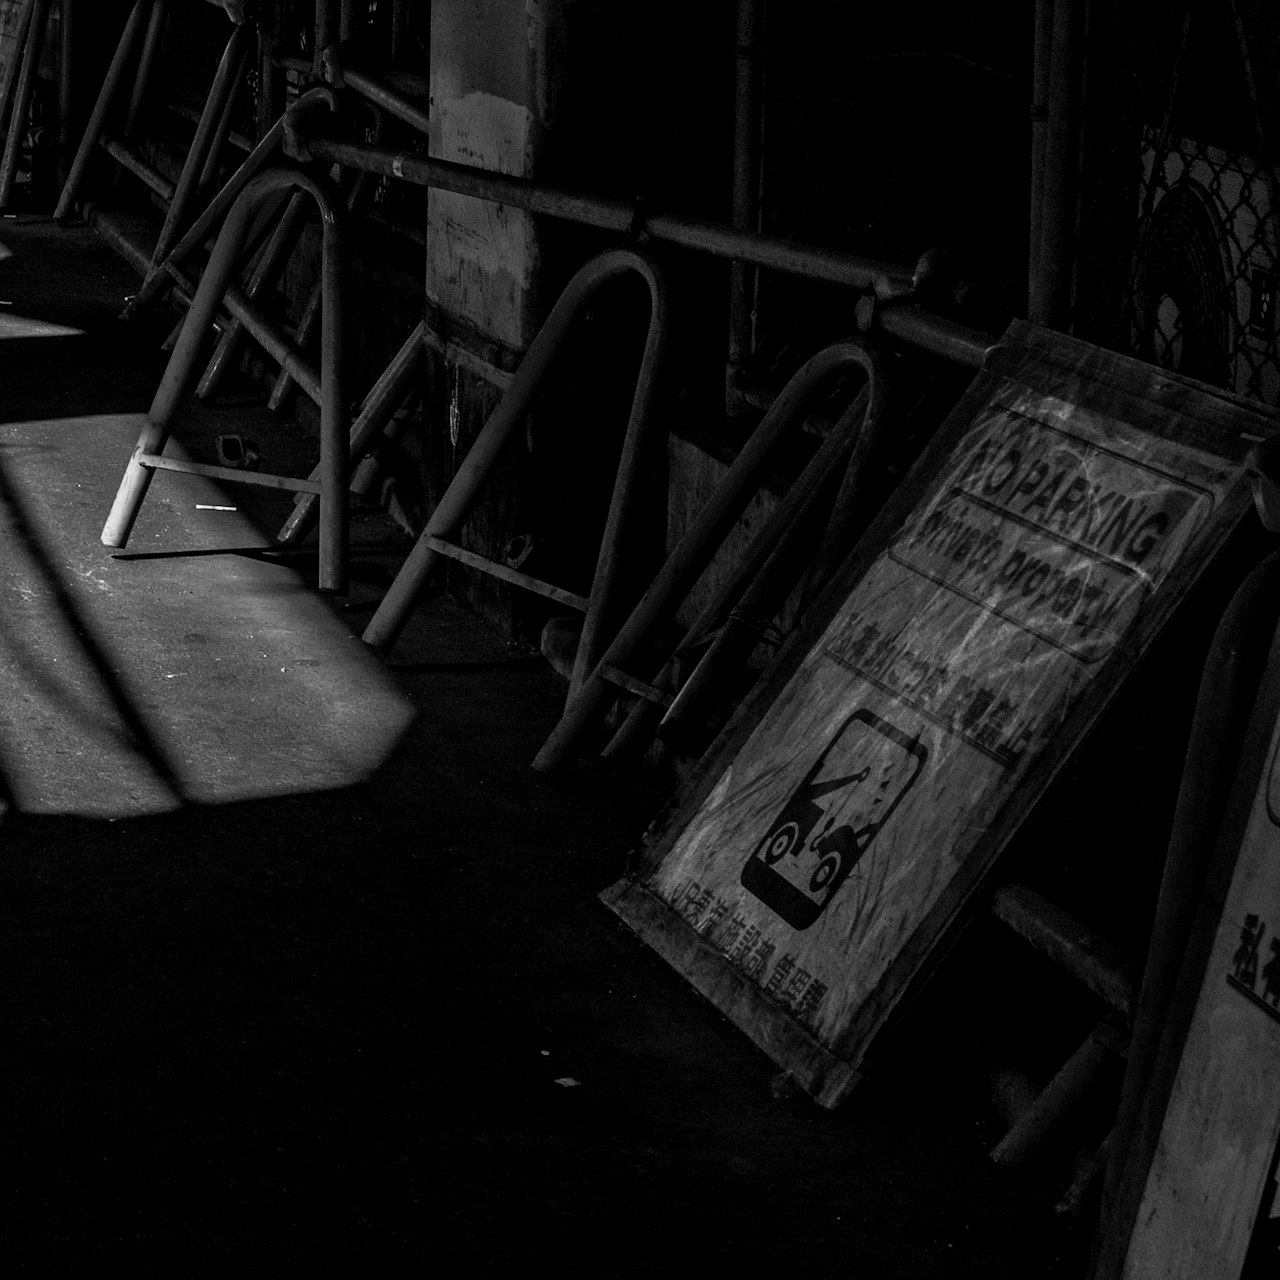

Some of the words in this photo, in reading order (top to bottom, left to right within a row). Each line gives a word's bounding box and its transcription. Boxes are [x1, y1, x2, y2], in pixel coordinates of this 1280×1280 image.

[959, 437, 1024, 498] NO
[1004, 458, 1172, 564] PARKING
[911, 508, 1006, 573] private
[993, 548, 1122, 639] property
